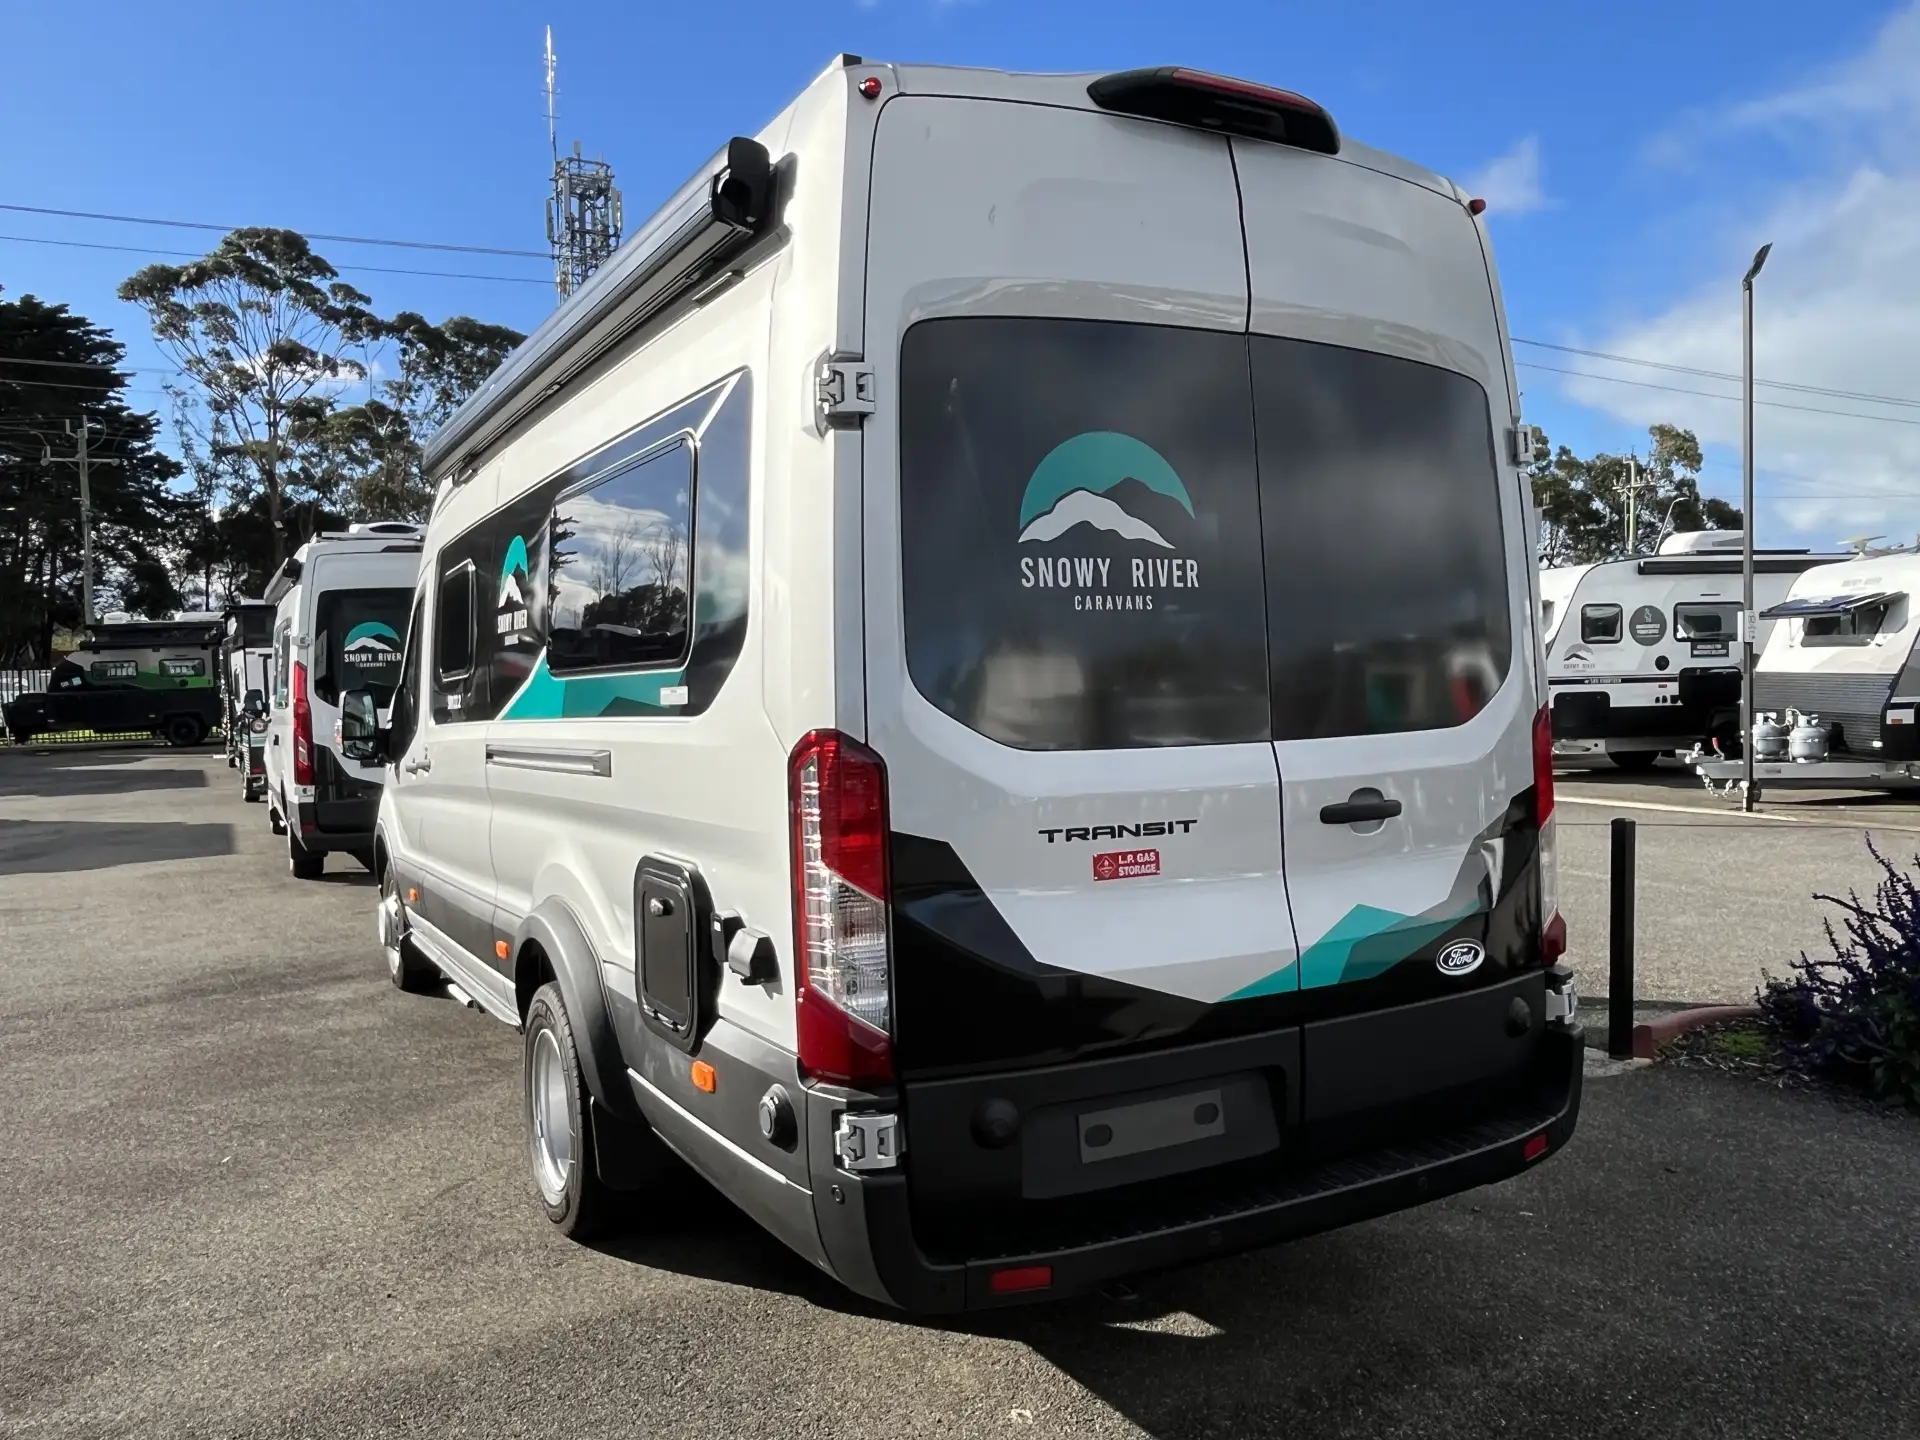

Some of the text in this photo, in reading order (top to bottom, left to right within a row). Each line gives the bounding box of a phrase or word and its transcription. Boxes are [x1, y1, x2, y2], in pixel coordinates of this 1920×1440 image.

[1020, 557, 1200, 588] SNOWY RIVER
[1074, 595, 1154, 611] CARAVANS
[343, 652, 402, 662] SNOWY RIVER
[1038, 819, 1198, 844] TRANSIT
[1118, 851, 1156, 865] L.P. GAS
[1118, 863, 1157, 877] STORAGE
[1448, 947, 1475, 967] Ford
